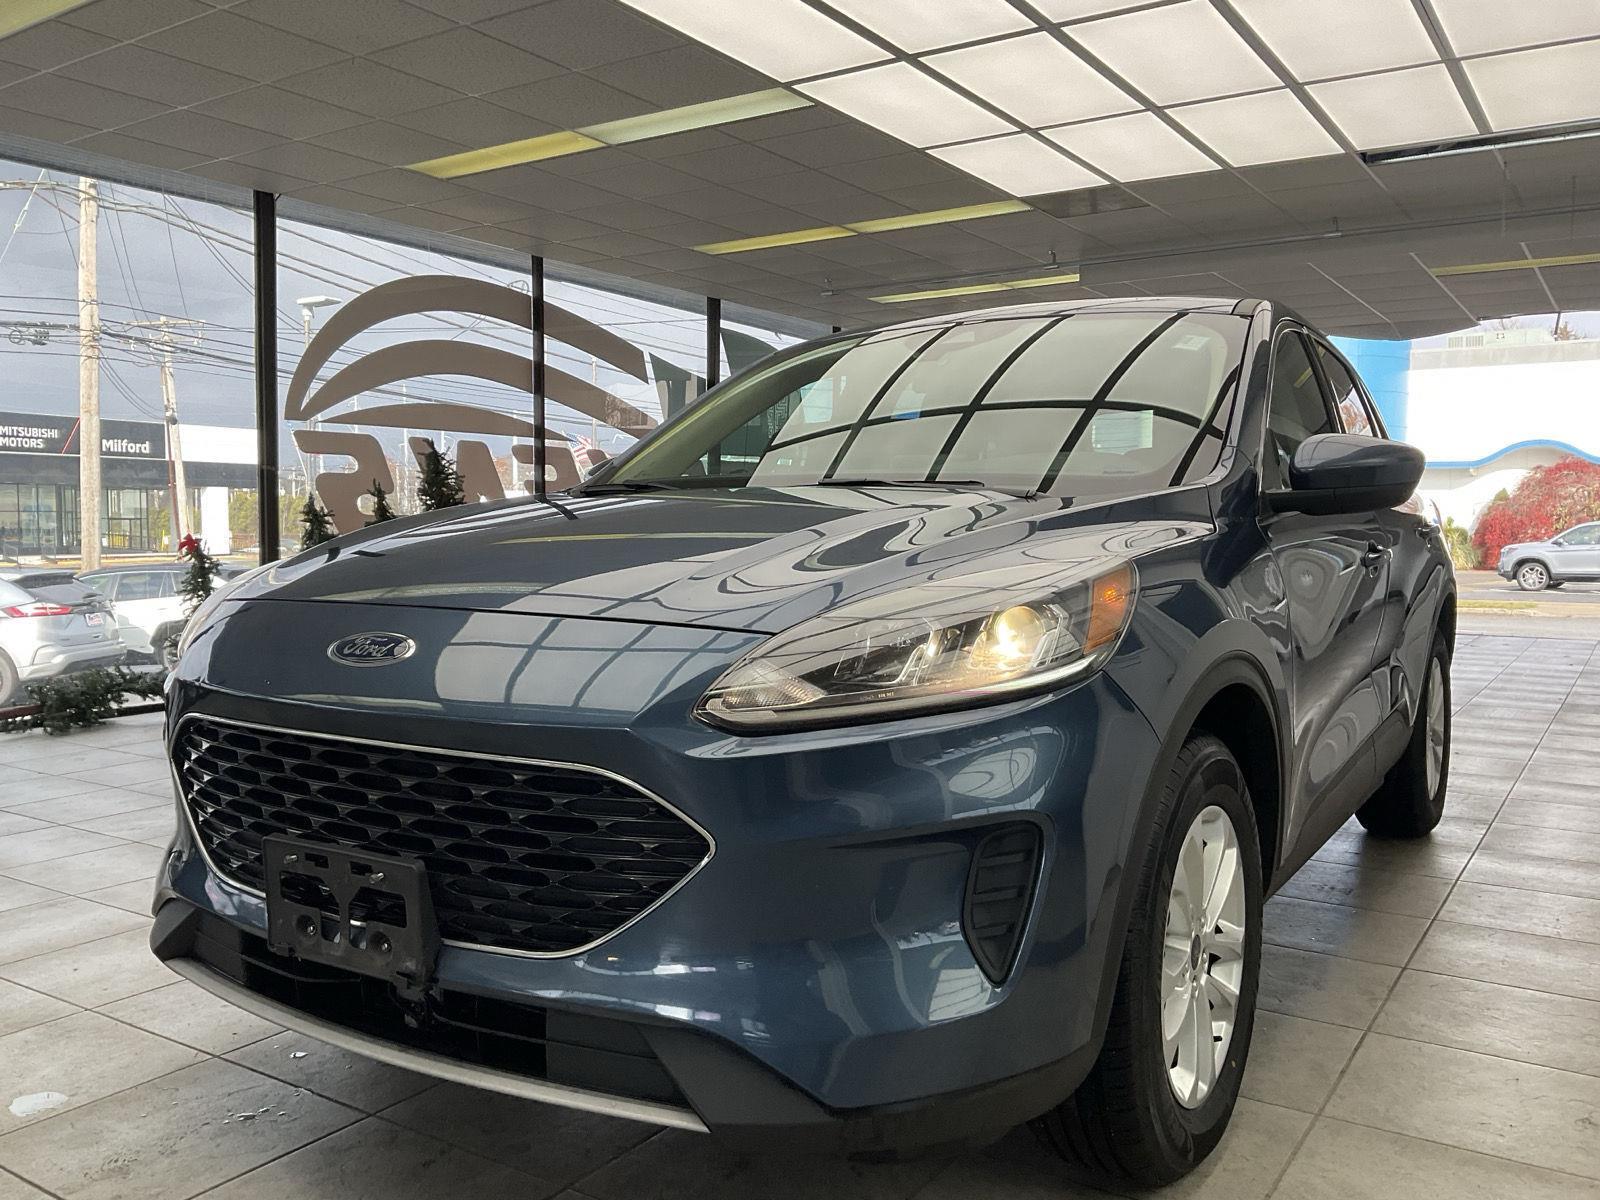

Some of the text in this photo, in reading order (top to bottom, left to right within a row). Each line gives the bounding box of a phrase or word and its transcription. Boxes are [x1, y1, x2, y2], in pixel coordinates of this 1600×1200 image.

[0, 425, 58, 439] MITSUBISHI
[0, 436, 45, 449] MOTORS
[101, 438, 150, 454] Milford
[343, 635, 395, 658] Ford
